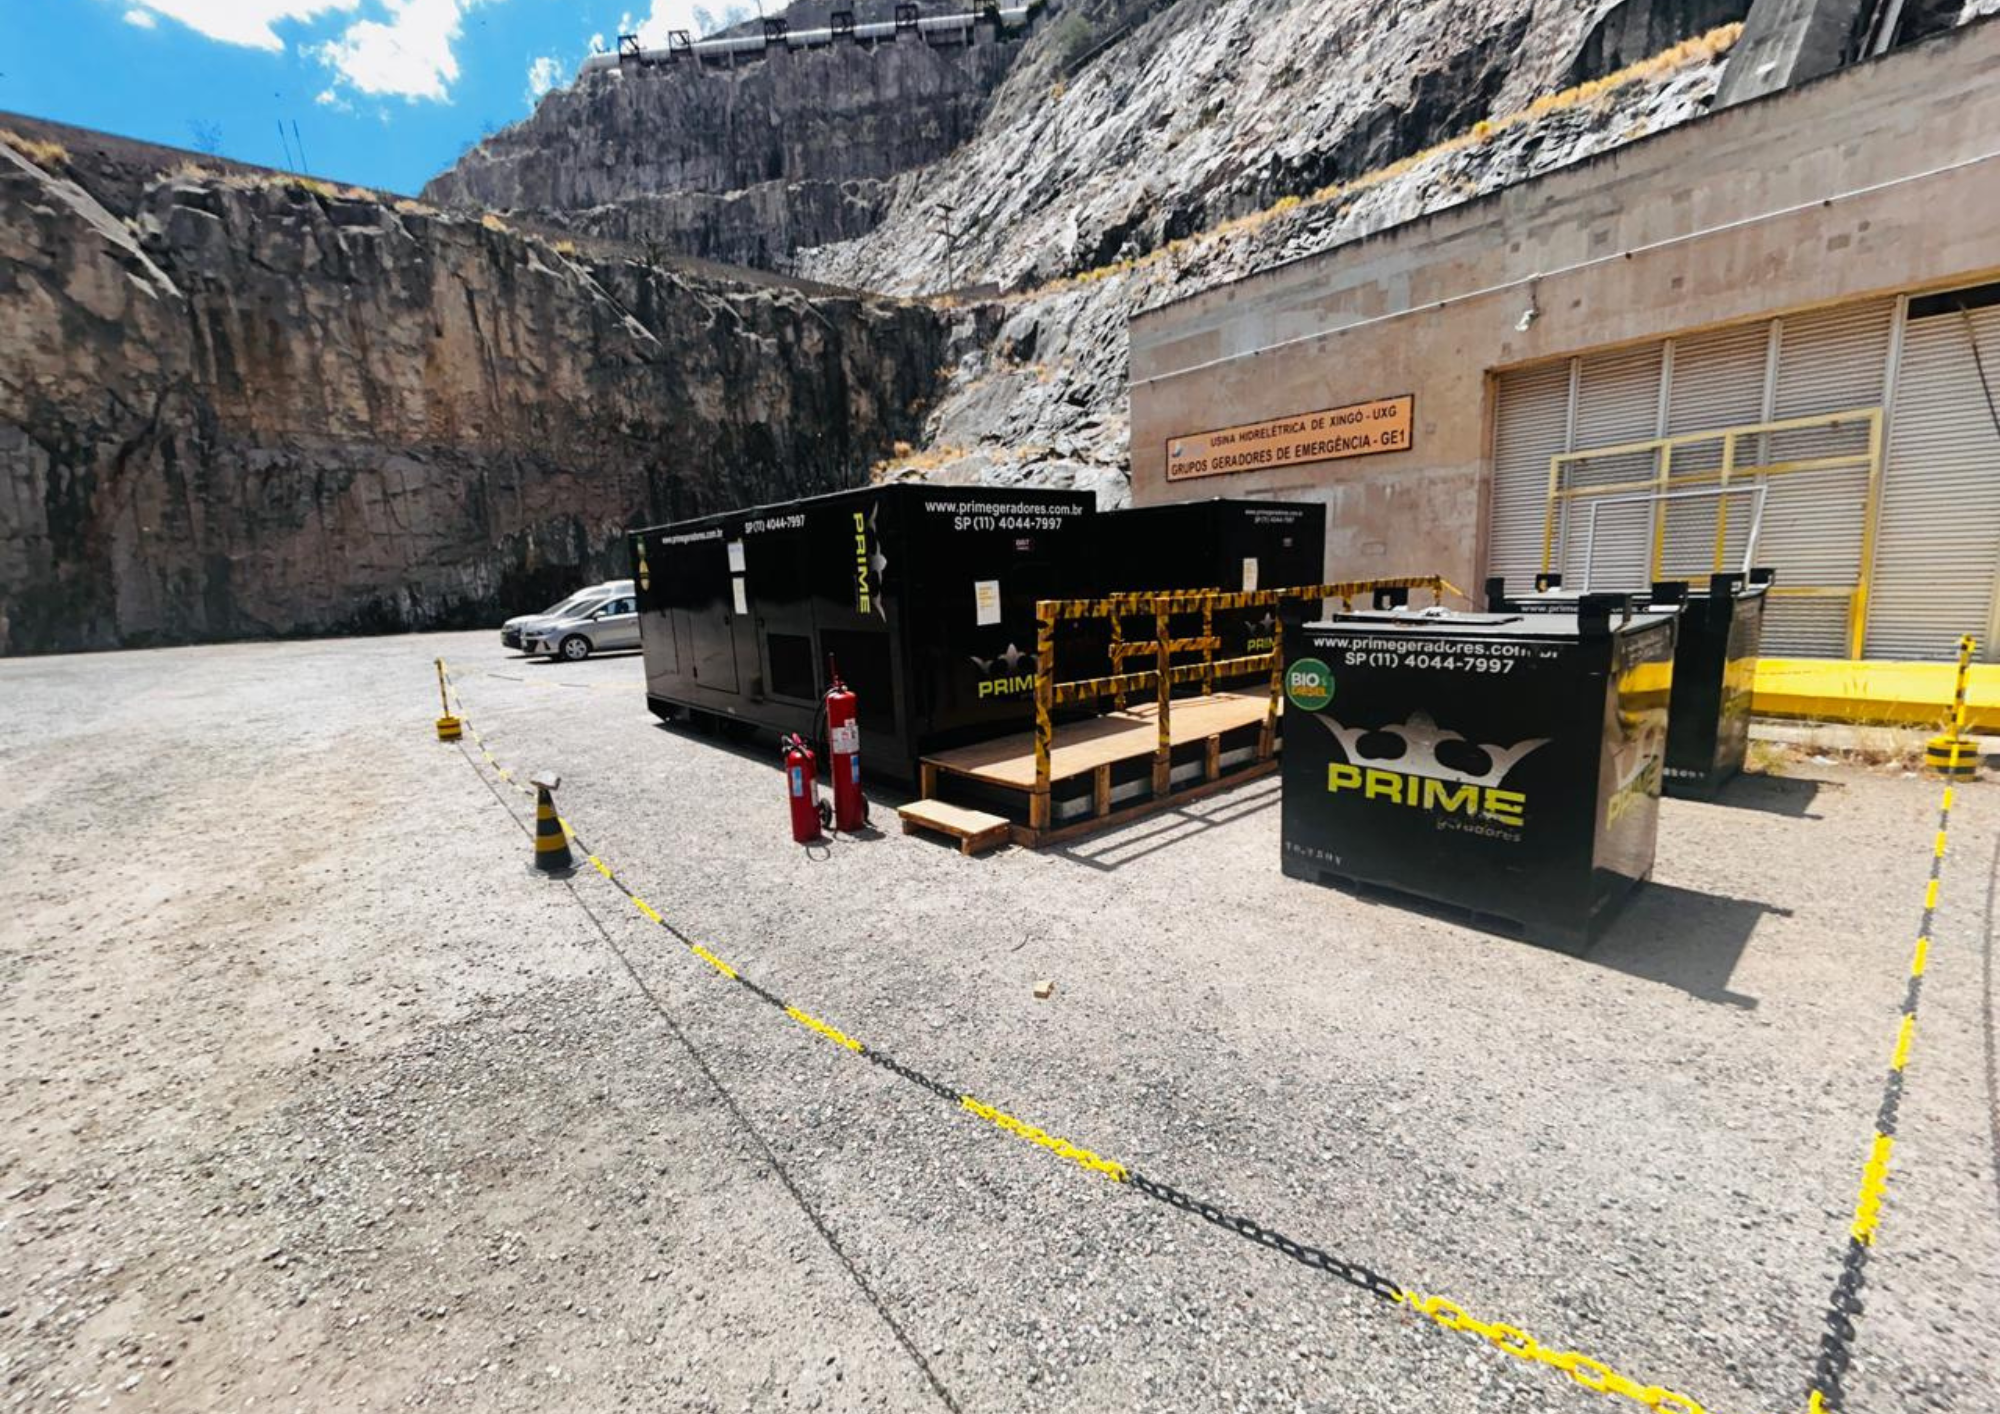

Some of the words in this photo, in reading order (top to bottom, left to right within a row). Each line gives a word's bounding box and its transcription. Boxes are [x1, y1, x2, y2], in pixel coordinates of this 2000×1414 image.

[1210, 434, 1236, 448] USINA
[1239, 421, 1307, 442] HIDRELÉTRICA
[1311, 417, 1325, 430] DE
[1329, 409, 1364, 428] XINGÓ
[1372, 405, 1398, 421] UXG
[1171, 459, 1208, 477] GRUPOS
[1211, 450, 1273, 470] GERADORES
[1277, 445, 1291, 461] DE
[1295, 434, 1371, 459] EMERGÊNCIA
[1381, 429, 1406, 447] GE1
[925, 500, 1083, 517] www.primegeradores.com.br
[998, 517, 1063, 531] 4044-7997
[853, 512, 871, 614] PRIME
[1314, 636, 1558, 659] www.primegeradores.com
[1344, 652, 1367, 666] SP
[1404, 654, 1515, 674] 4044-7997
[978, 673, 1037, 698] PRIM
[1291, 672, 1320, 687] BIO
[1327, 762, 1526, 827] PRIME
